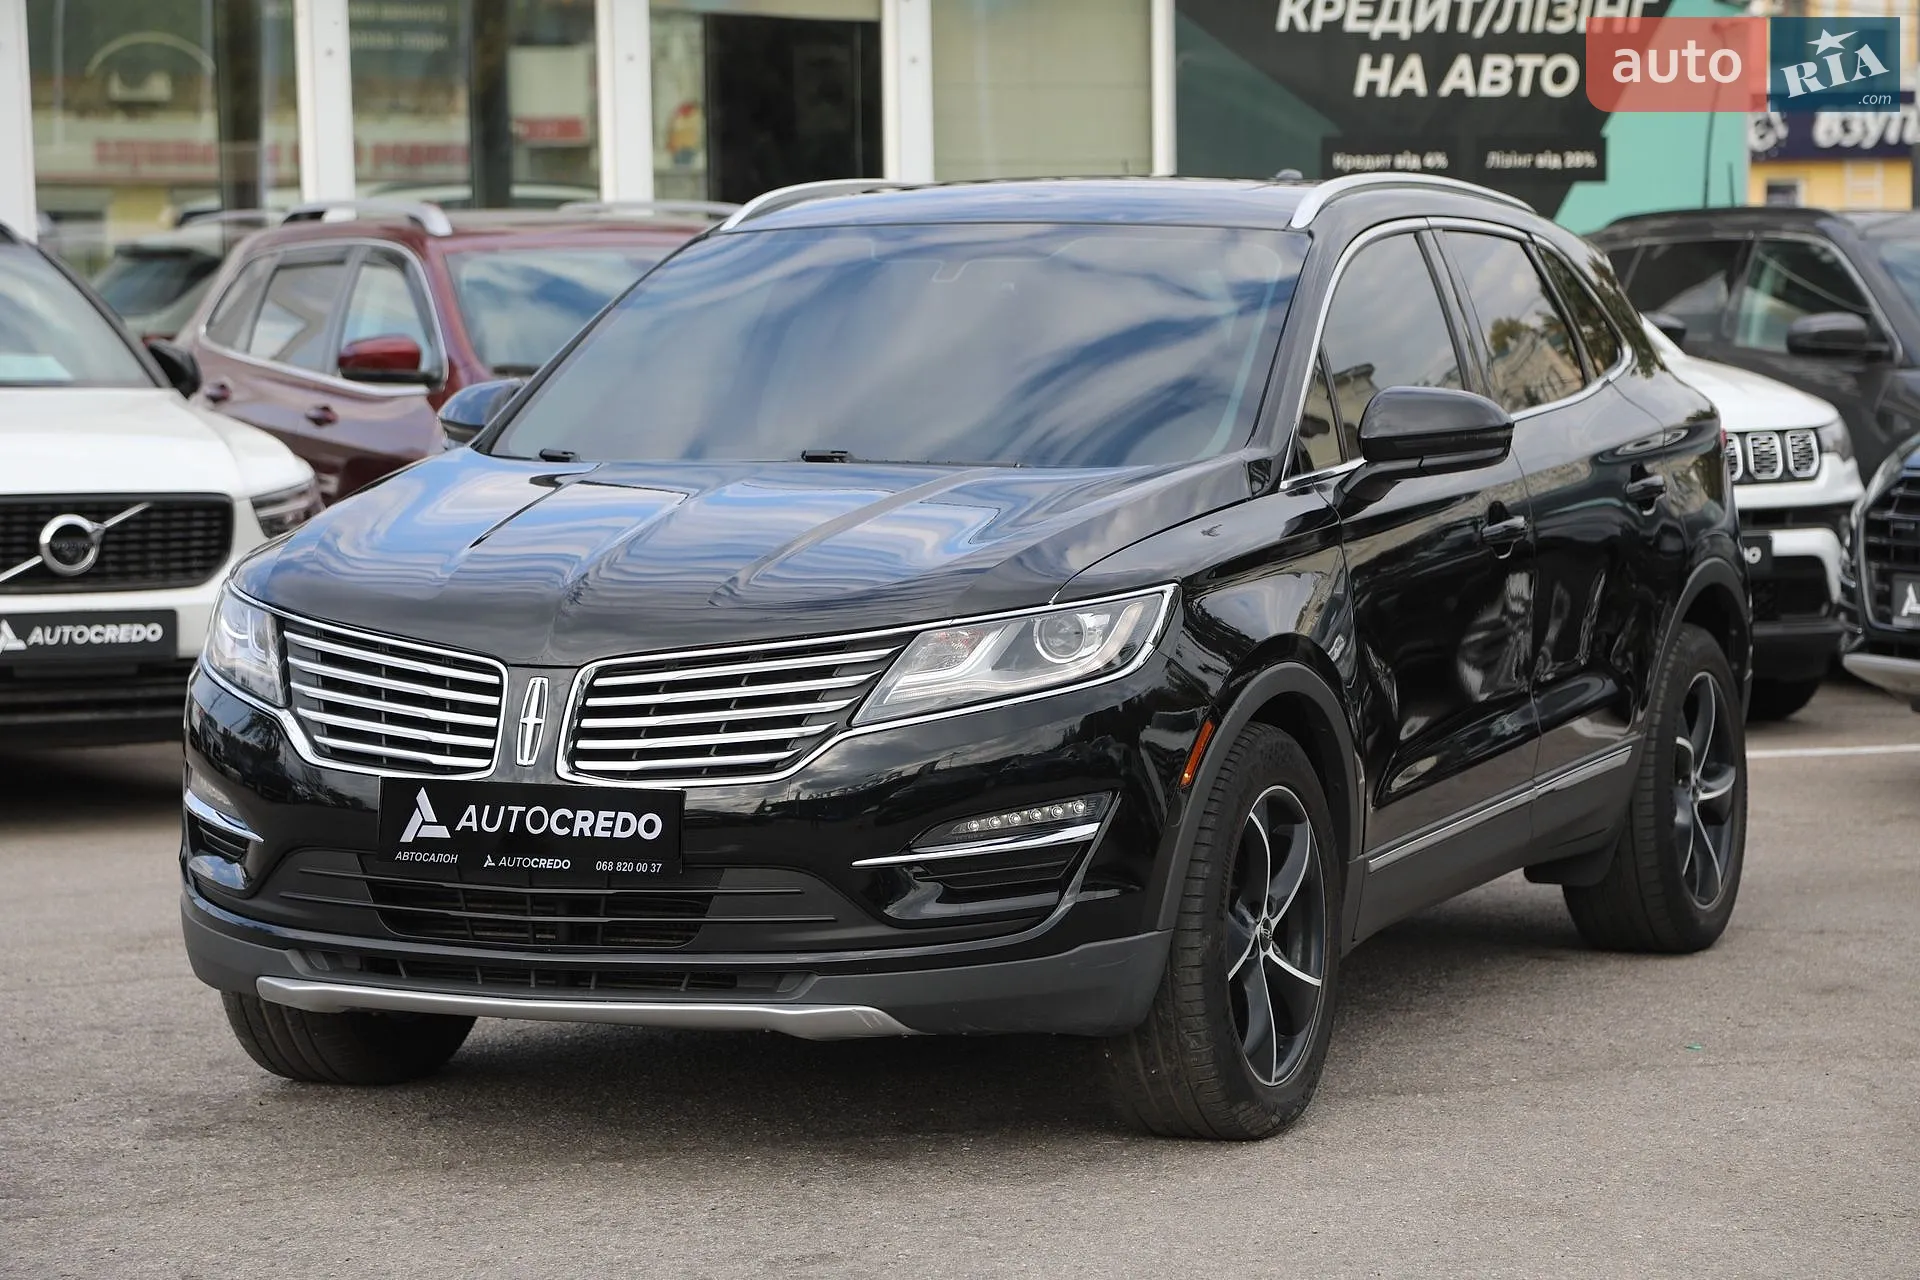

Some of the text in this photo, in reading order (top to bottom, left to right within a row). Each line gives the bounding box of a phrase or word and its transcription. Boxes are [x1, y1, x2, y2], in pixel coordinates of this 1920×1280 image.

[1353, 53, 1581, 98] НА АВТО
[27, 623, 163, 646] AUTOCREDO
[455, 804, 663, 840] AUTOCREDO
[394, 851, 459, 864] АВТОСАЛОН
[498, 856, 571, 870] AUTOCREDO
[596, 860, 662, 873] 068 820 00 37
